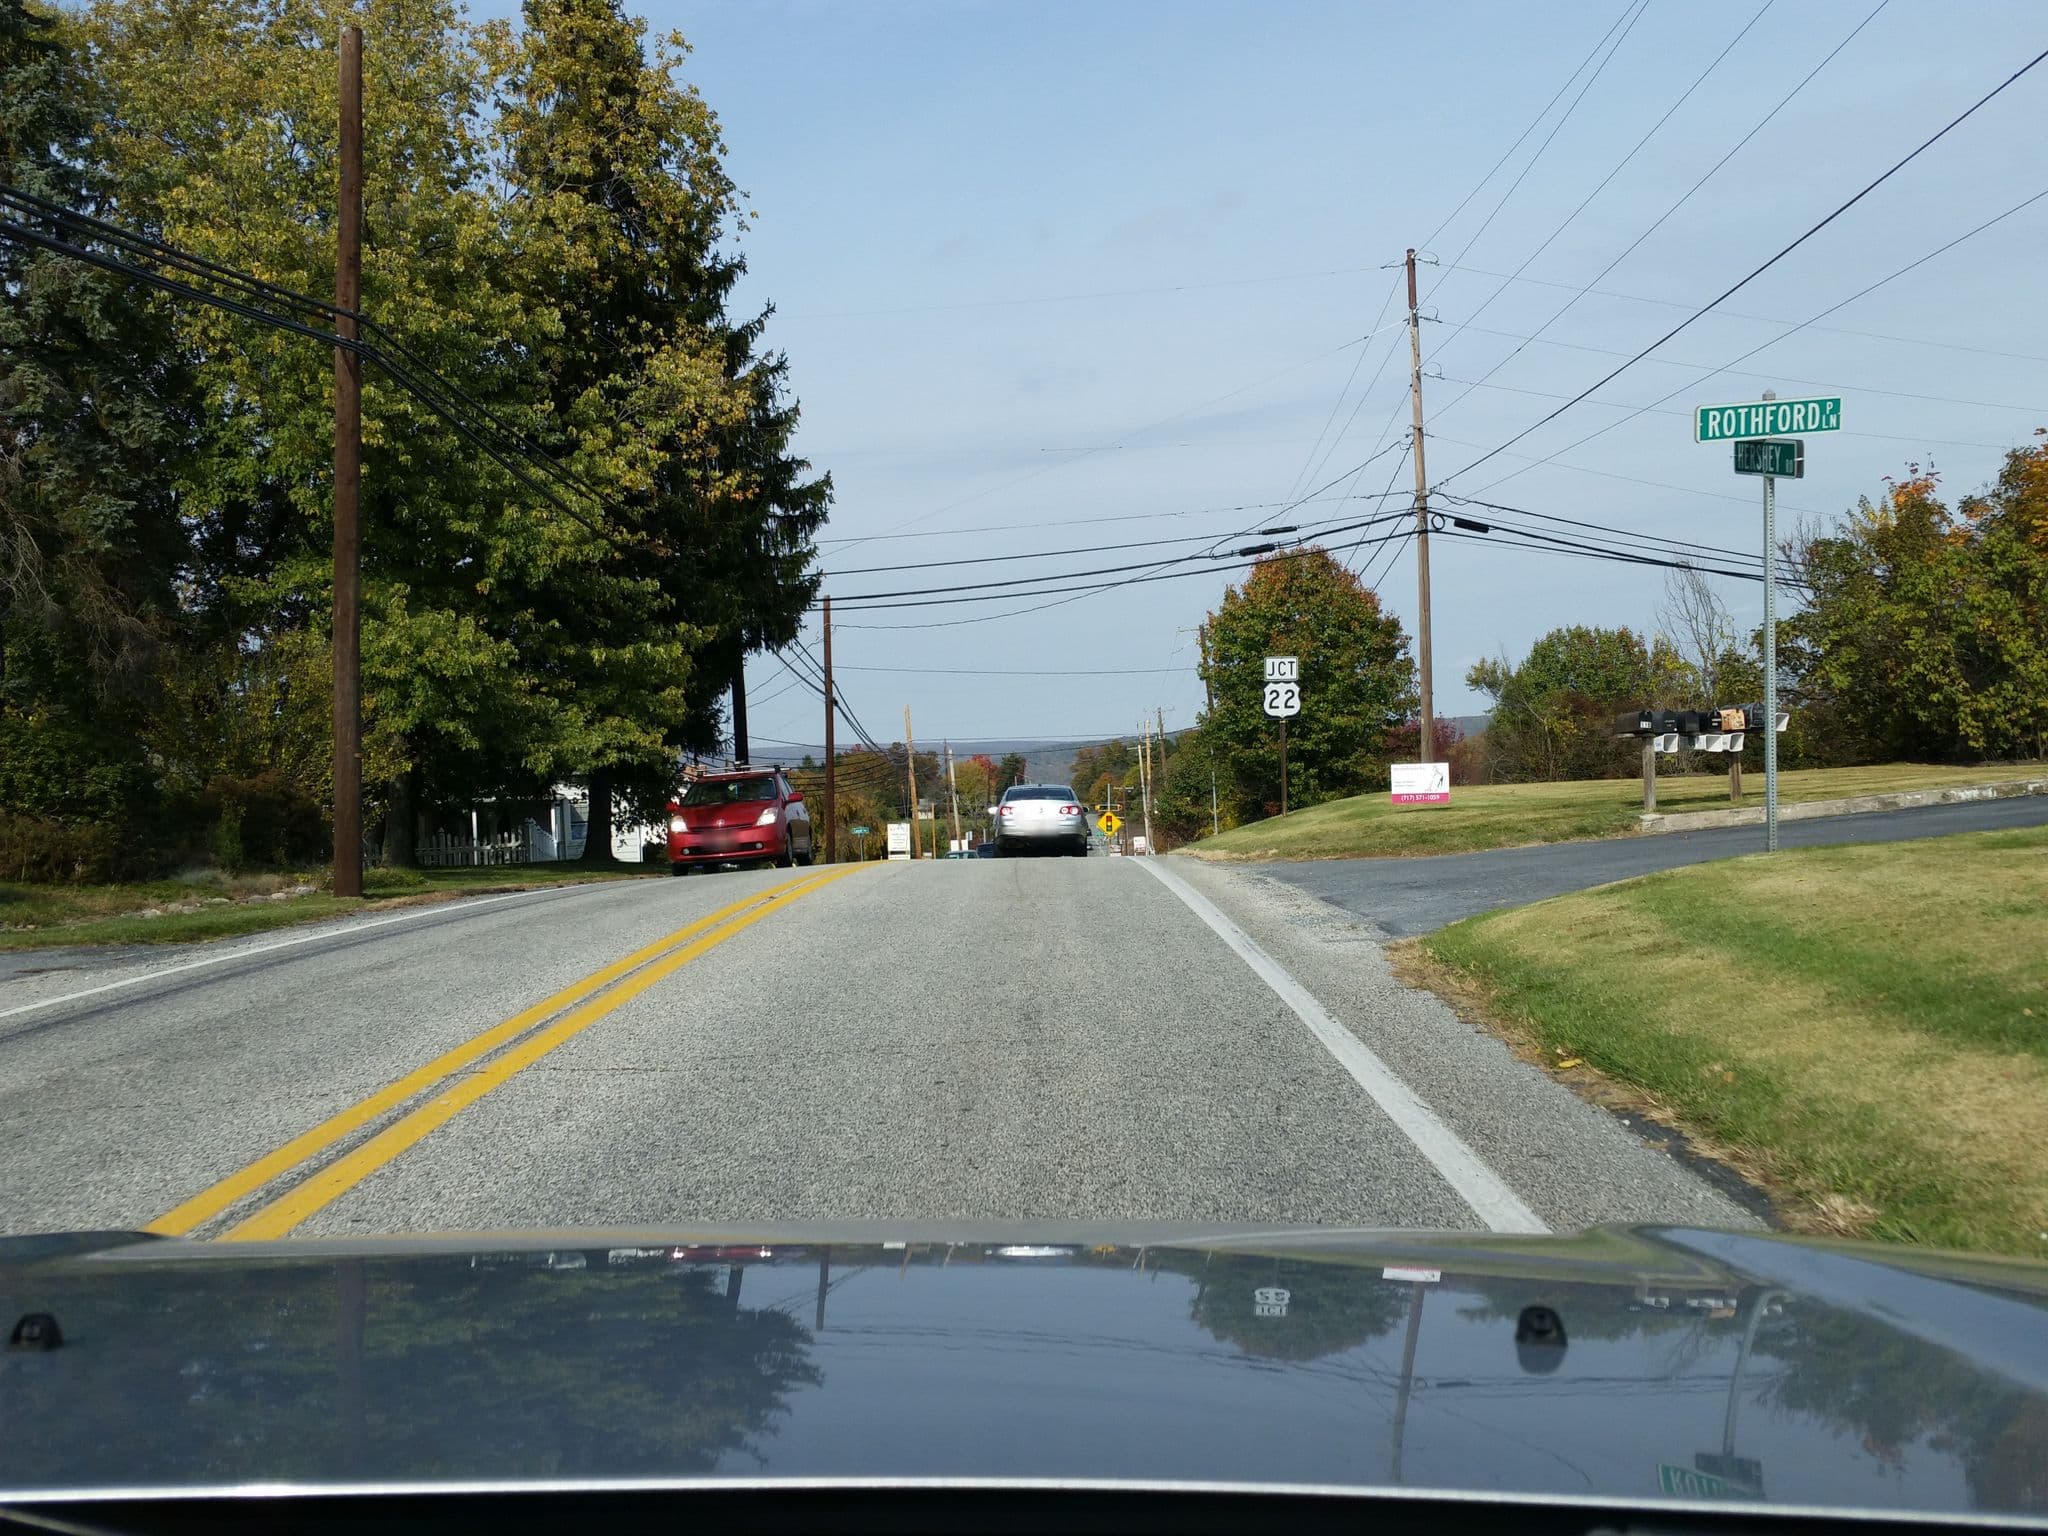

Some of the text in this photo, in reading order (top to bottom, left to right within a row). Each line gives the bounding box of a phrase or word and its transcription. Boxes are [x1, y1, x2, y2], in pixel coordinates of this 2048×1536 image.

[1708, 402, 1820, 438] ROTHFORD
[1822, 414, 1837, 429] LN
[1737, 443, 1781, 473] HERSHEY
[1267, 661, 1296, 677] JCT
[1268, 689, 1295, 709] 22
